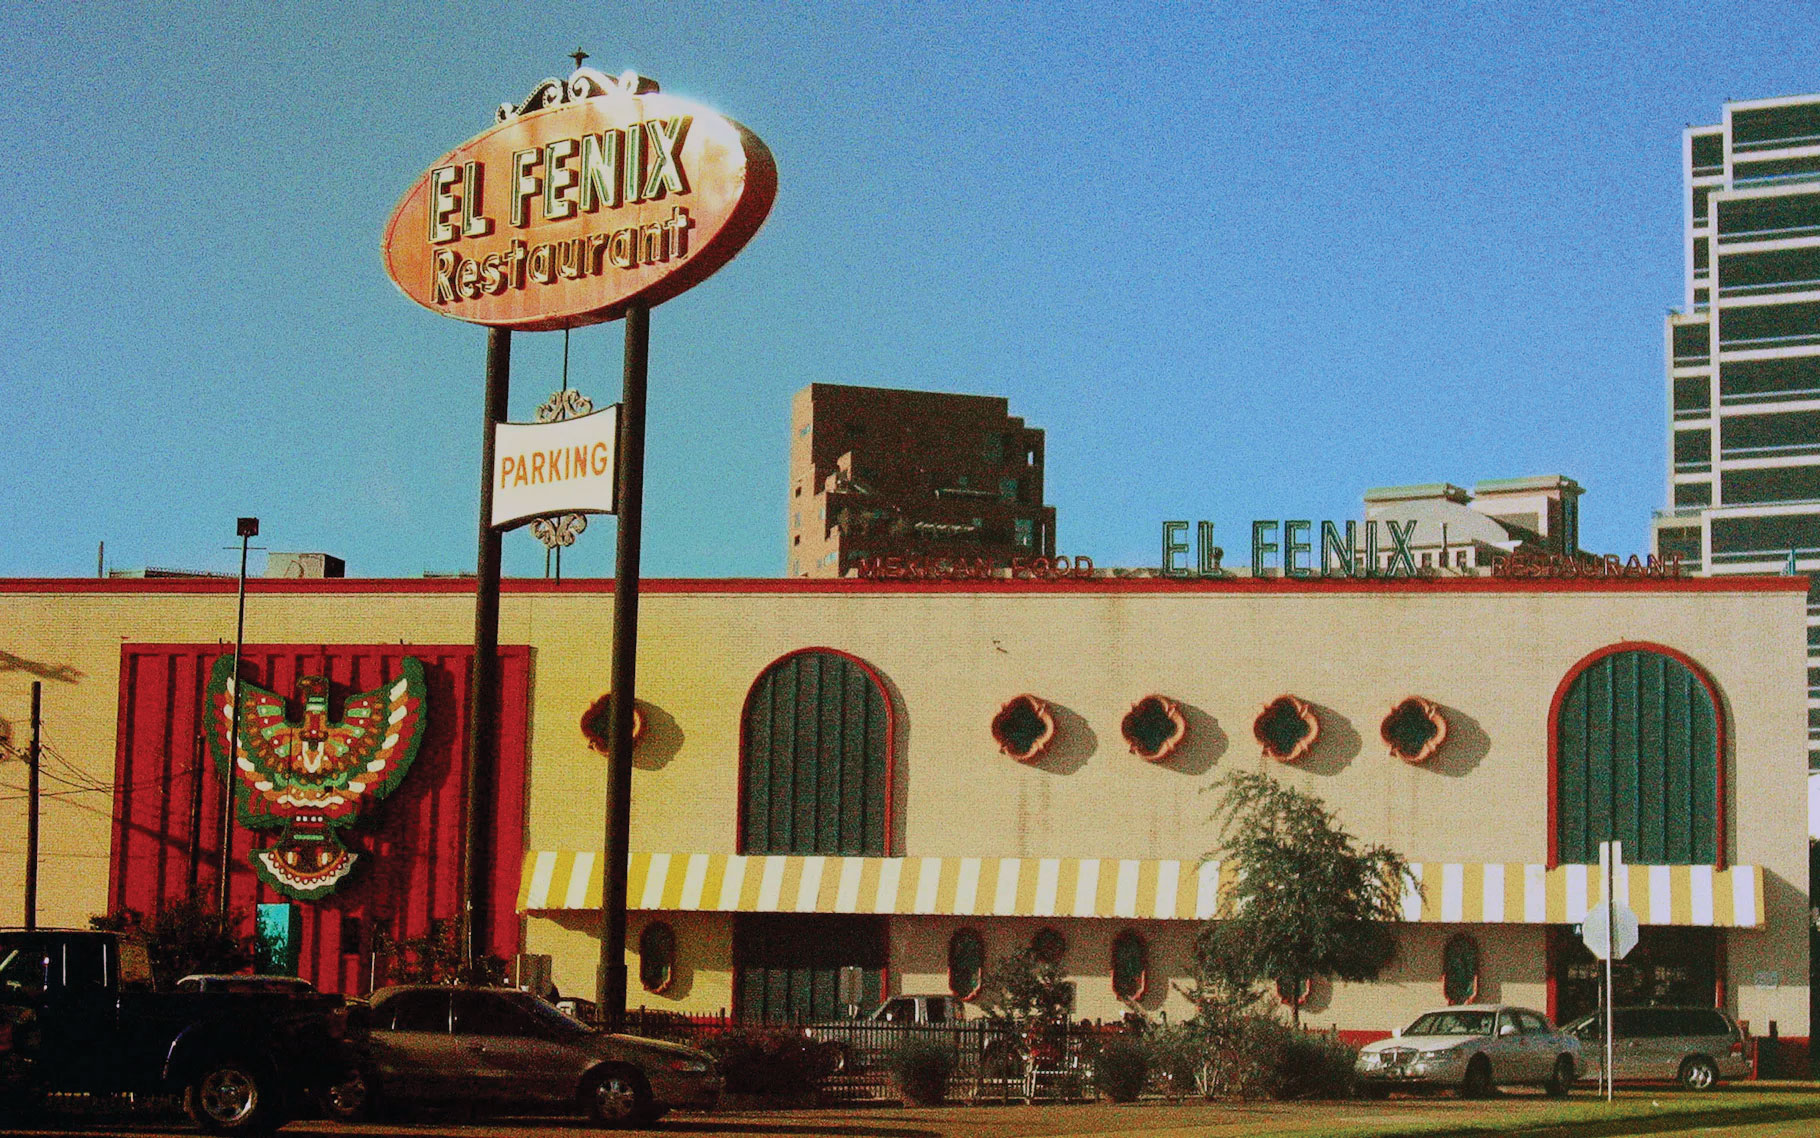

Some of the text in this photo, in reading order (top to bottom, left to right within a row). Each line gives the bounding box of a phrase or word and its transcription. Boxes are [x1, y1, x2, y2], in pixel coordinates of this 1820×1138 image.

[428, 115, 693, 244] EL FENIX
[430, 204, 695, 305] Restaurant
[500, 441, 608, 490] PARKING
[857, 555, 1095, 579] MEXICAN FOOD
[1162, 519, 1419, 578] EL FENIX
[1490, 552, 1686, 578] RESTAURANT
